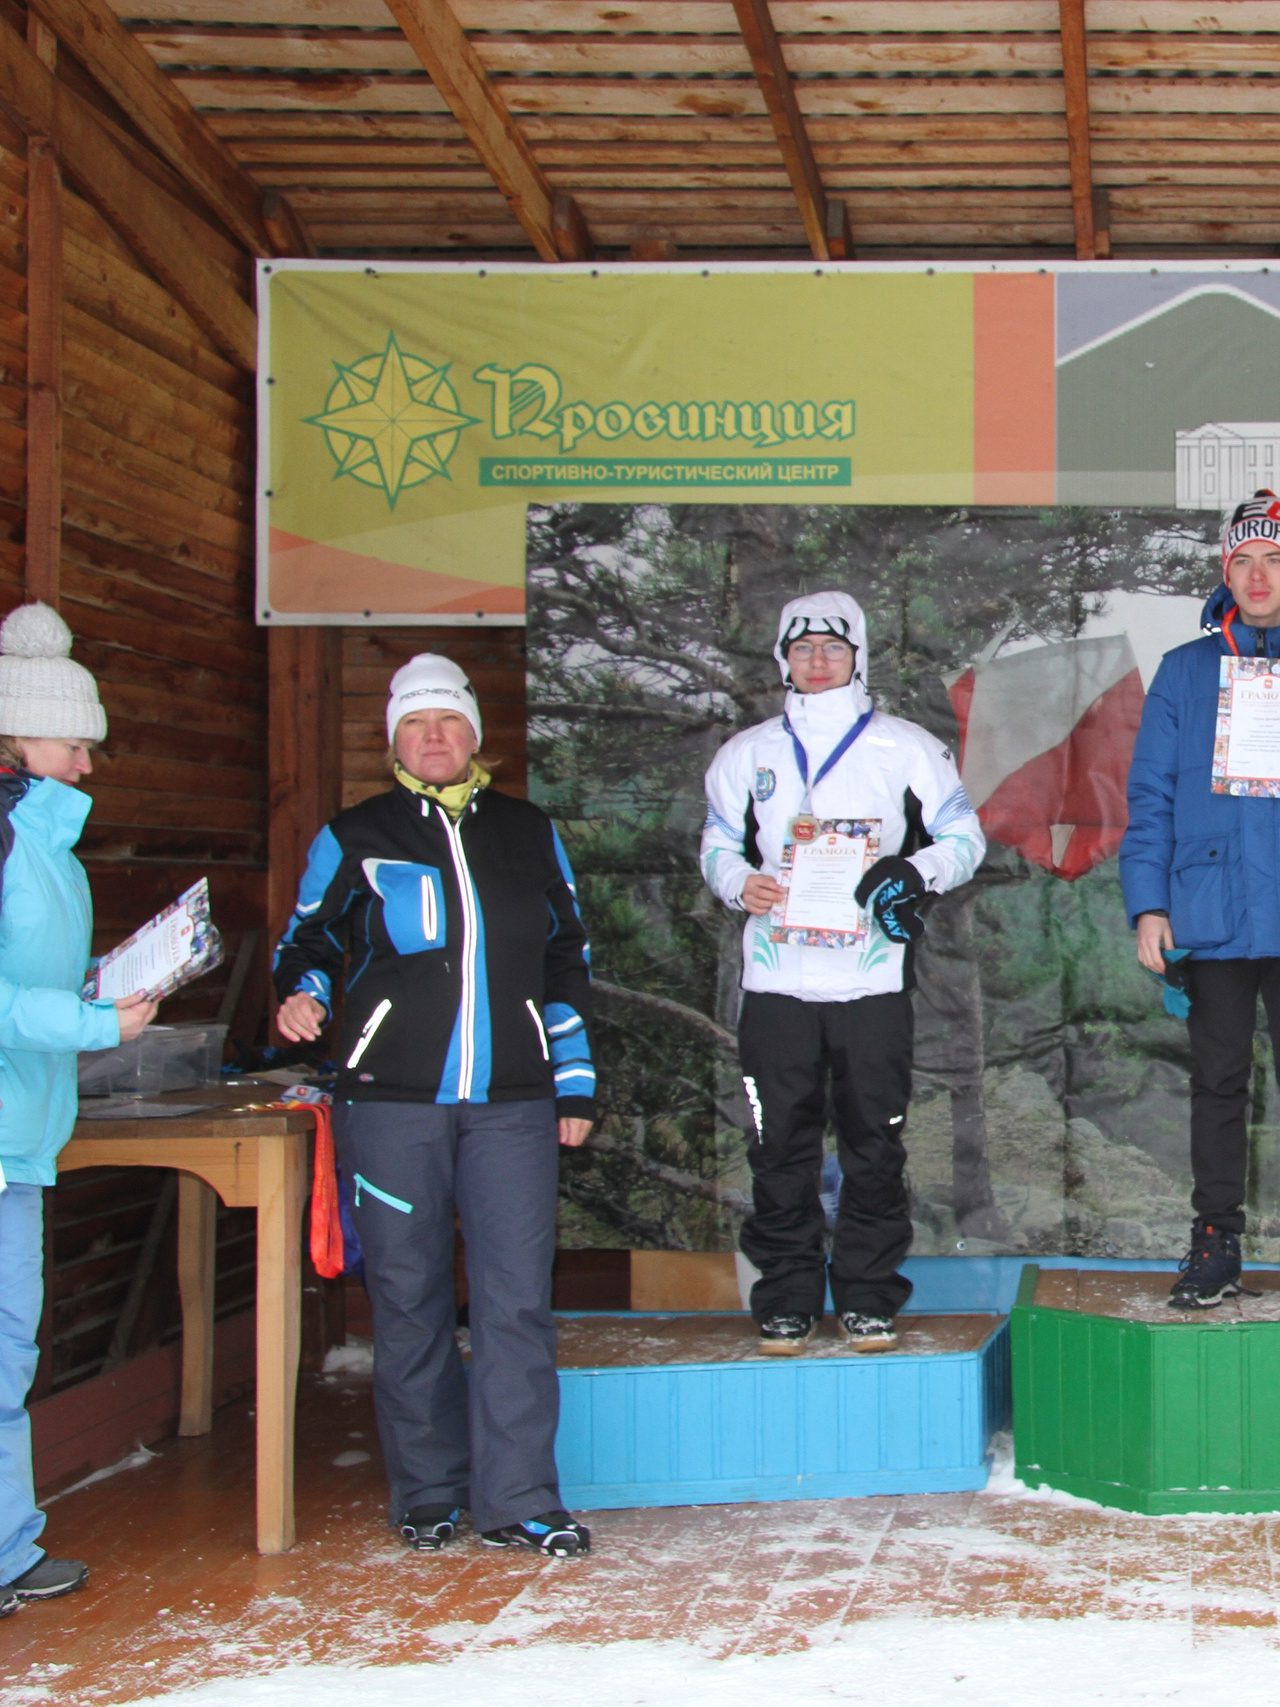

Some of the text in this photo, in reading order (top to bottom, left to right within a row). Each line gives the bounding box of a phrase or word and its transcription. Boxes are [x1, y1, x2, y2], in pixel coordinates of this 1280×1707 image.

[472, 362, 857, 453] Провинция
[491, 461, 840, 485] СПОРТИВНО-ТУРИСТИЧЕСКИЙ ЦЕНТР
